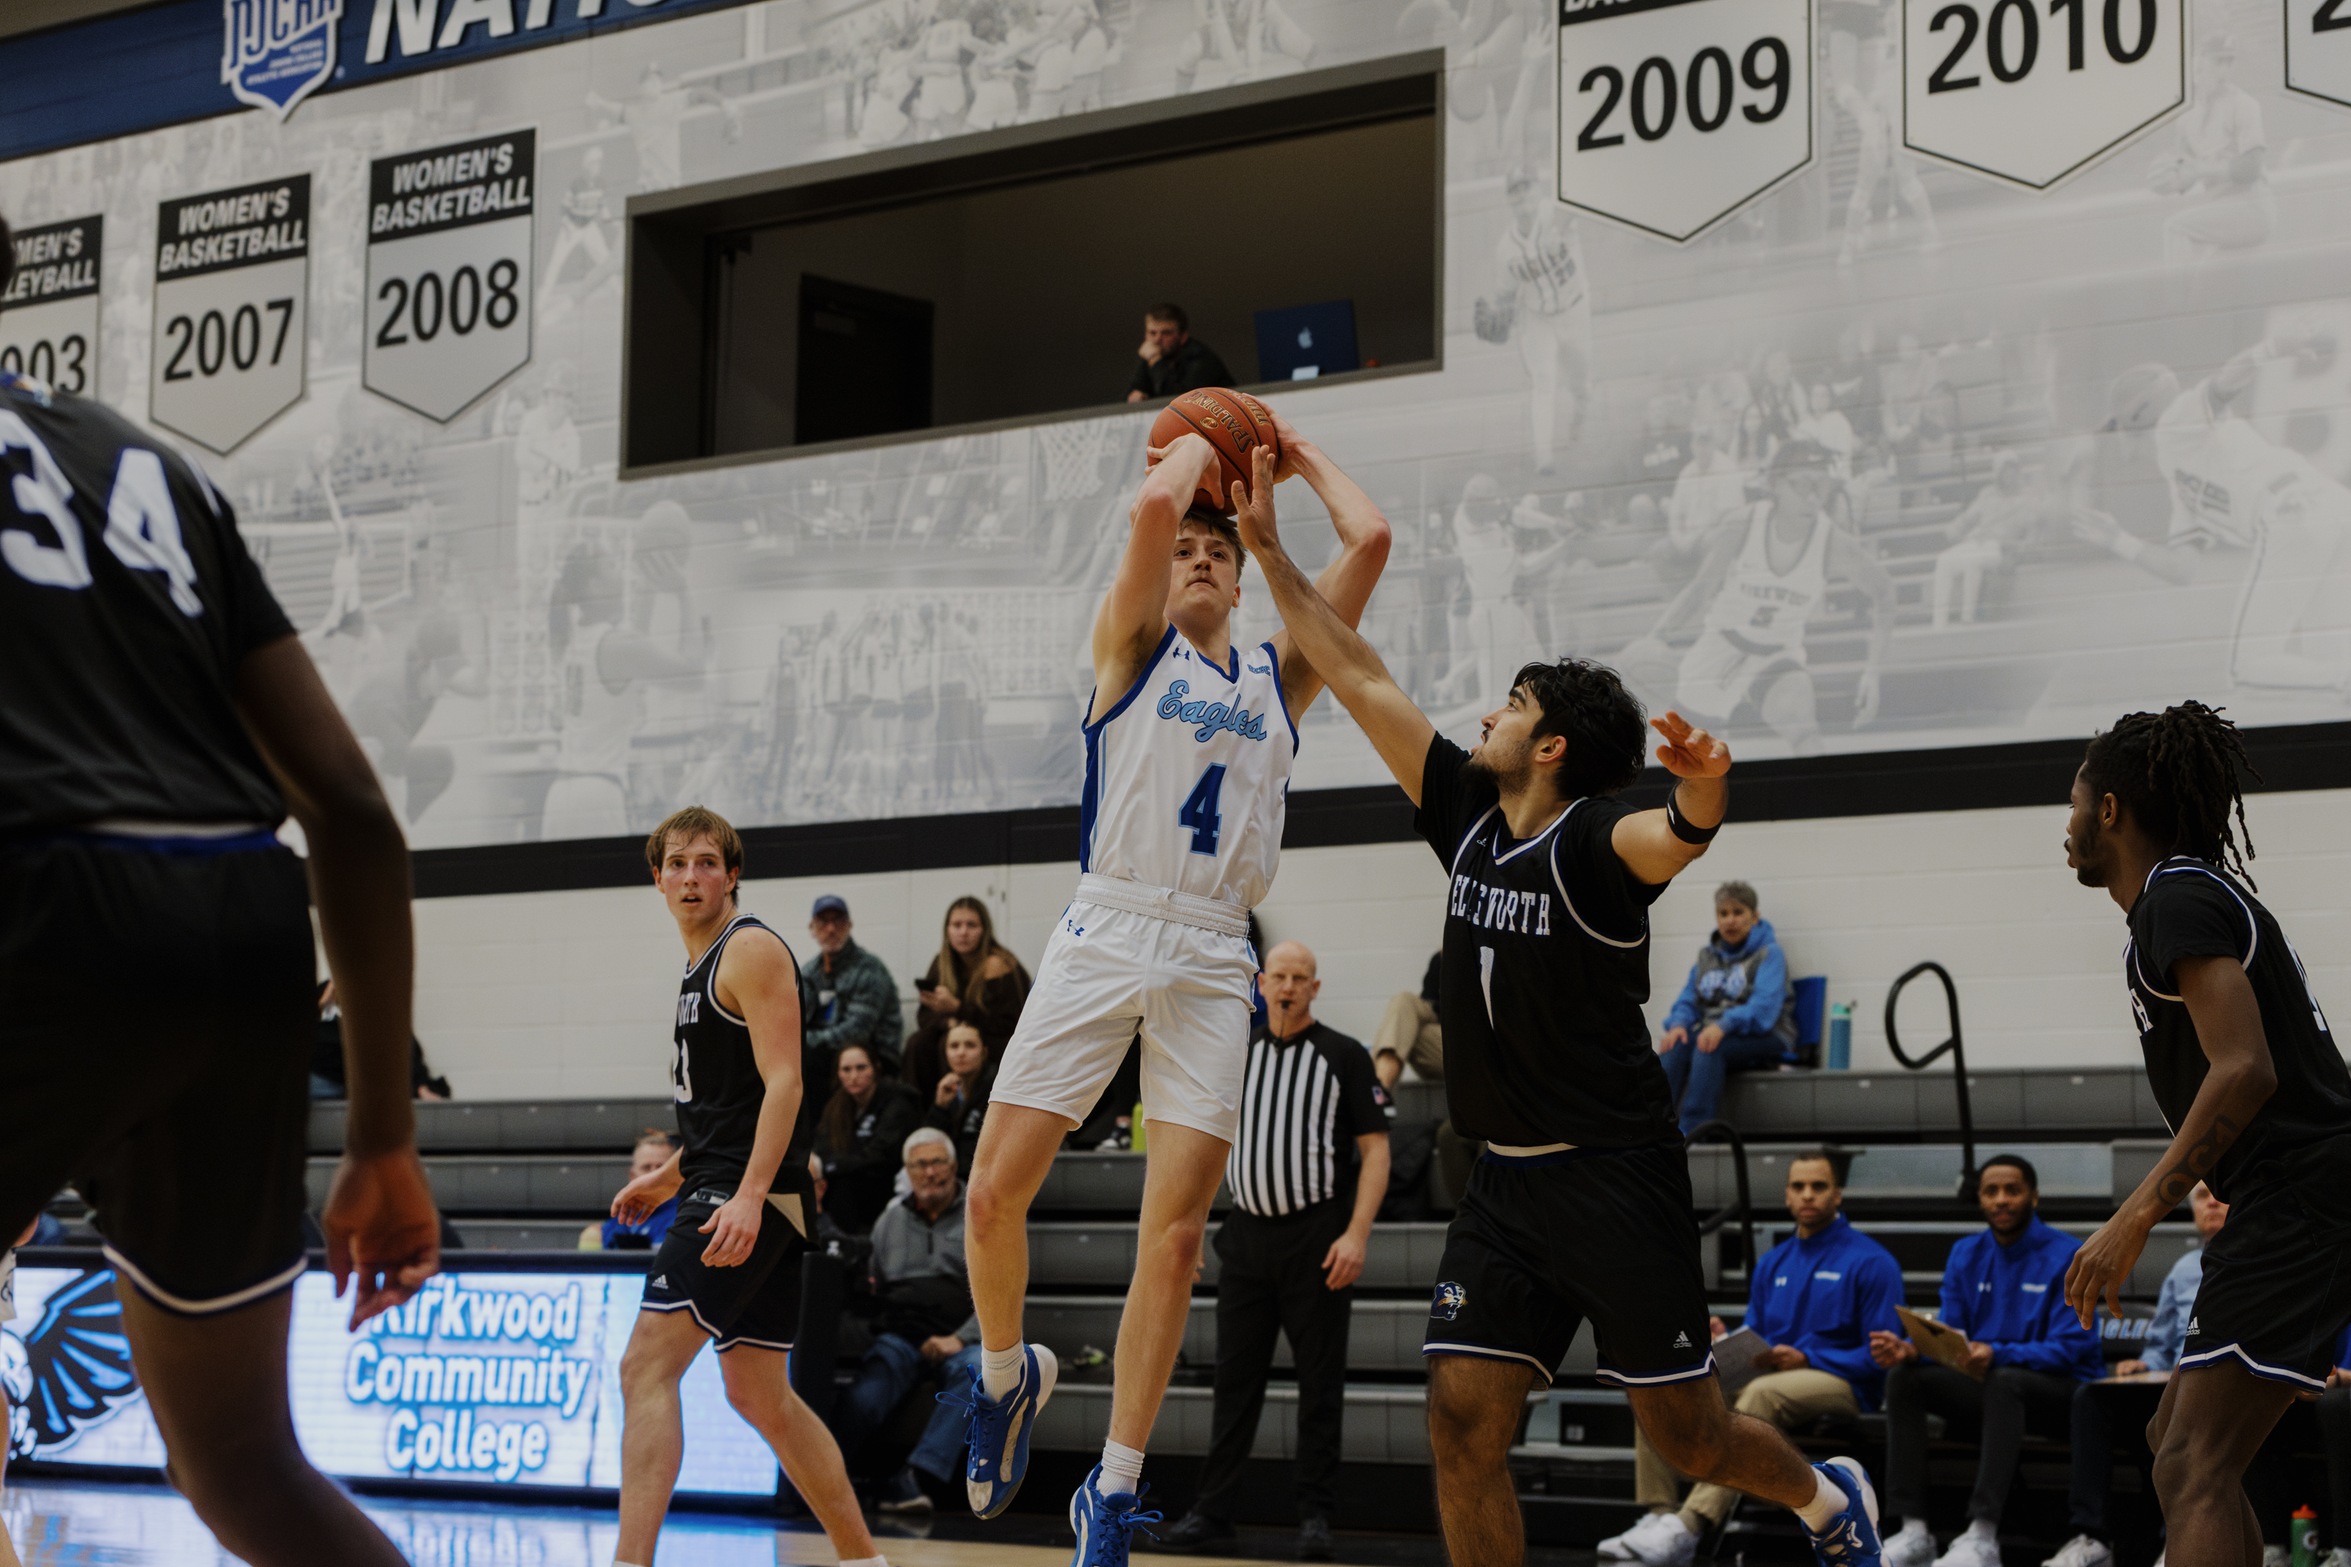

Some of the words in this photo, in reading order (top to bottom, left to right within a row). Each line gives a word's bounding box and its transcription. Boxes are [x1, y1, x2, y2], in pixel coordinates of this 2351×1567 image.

[1928, 0, 2157, 95] 2010
[1578, 36, 1791, 152] 2009
[371, 176, 532, 235] BASKETBALL
[392, 142, 513, 196] WOMEN'S
[158, 219, 306, 273] BASKETBALL
[178, 186, 291, 236] WOMEN'S
[163, 298, 294, 382] 2007
[376, 257, 519, 349] 2008
[1184, 390, 1256, 455] SPALDING
[0, 407, 203, 618] 34
[1156, 679, 1268, 743] Eagles
[1178, 762, 1223, 856] 4
[347, 1338, 592, 1421] Community
[384, 1407, 551, 1484] College
